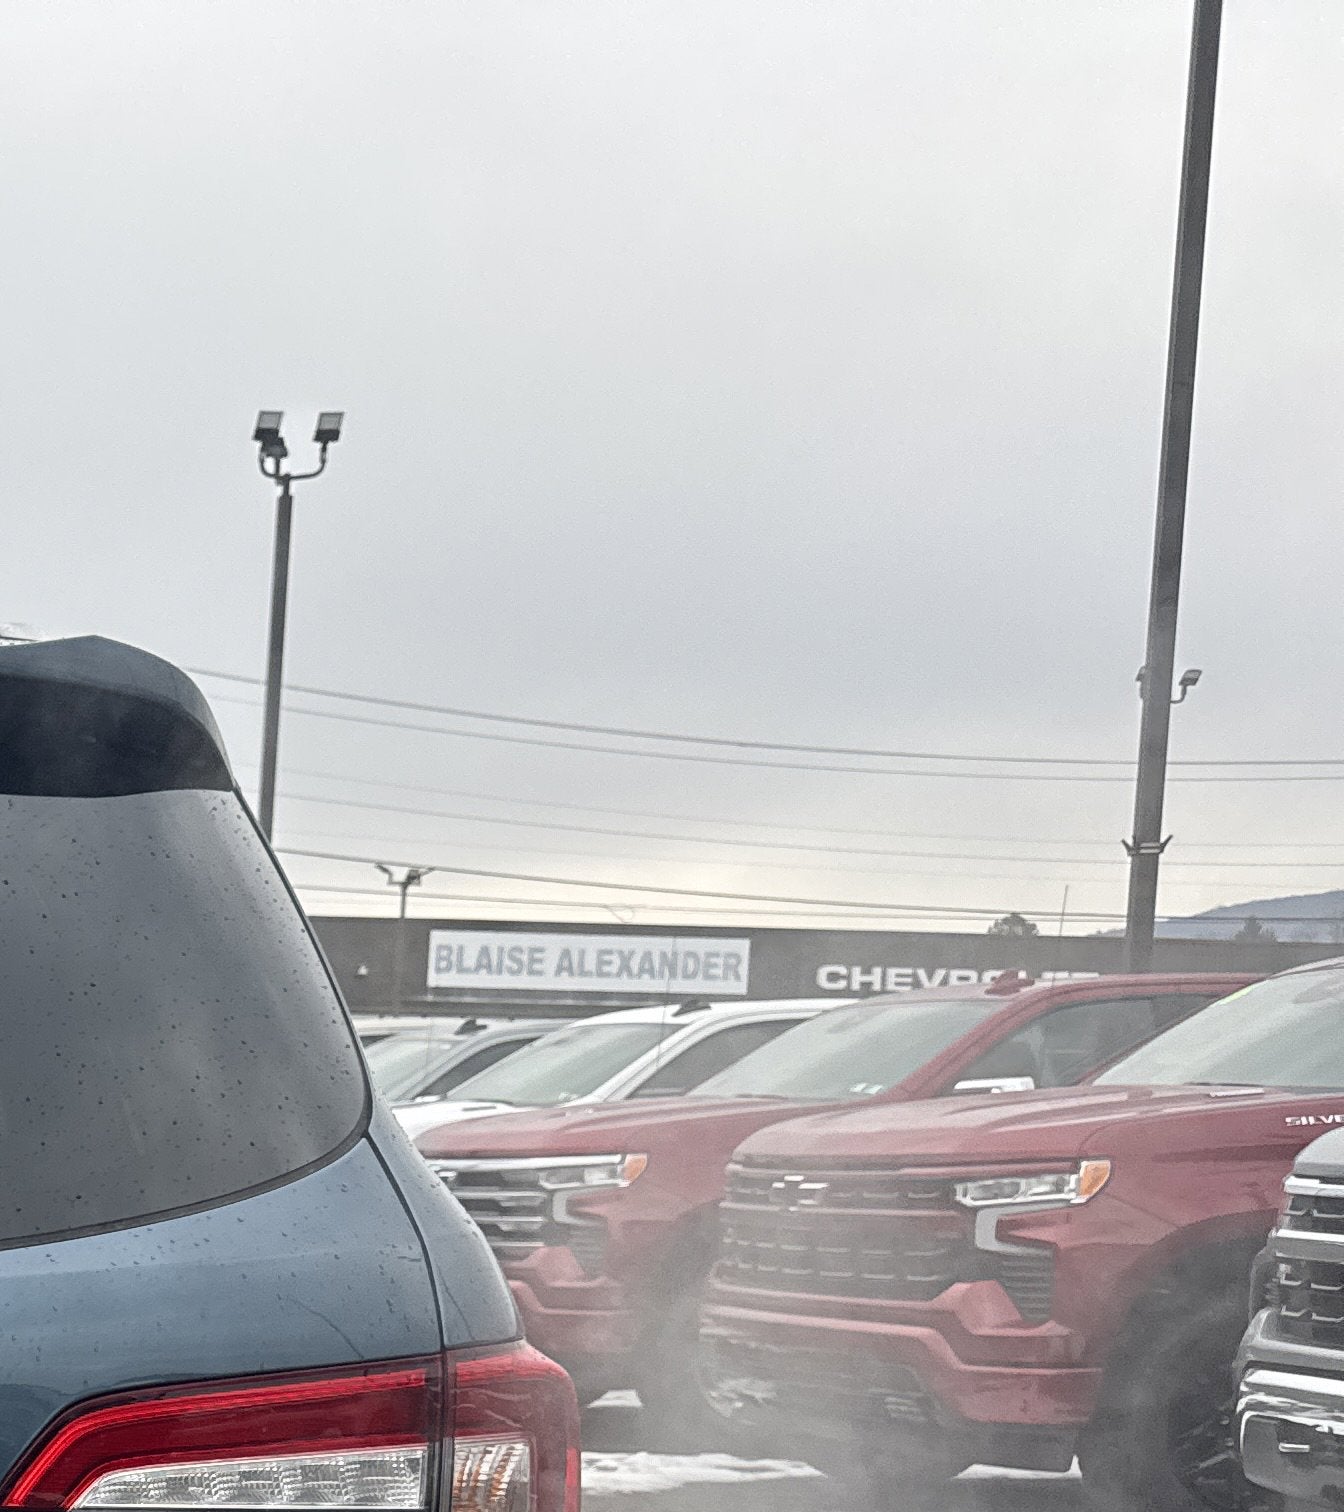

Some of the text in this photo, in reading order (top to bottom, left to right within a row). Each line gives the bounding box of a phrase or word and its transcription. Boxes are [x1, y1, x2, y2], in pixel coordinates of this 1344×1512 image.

[433, 944, 743, 982] BLAISE ALEXANDER
[816, 964, 1100, 992] CHEVR
